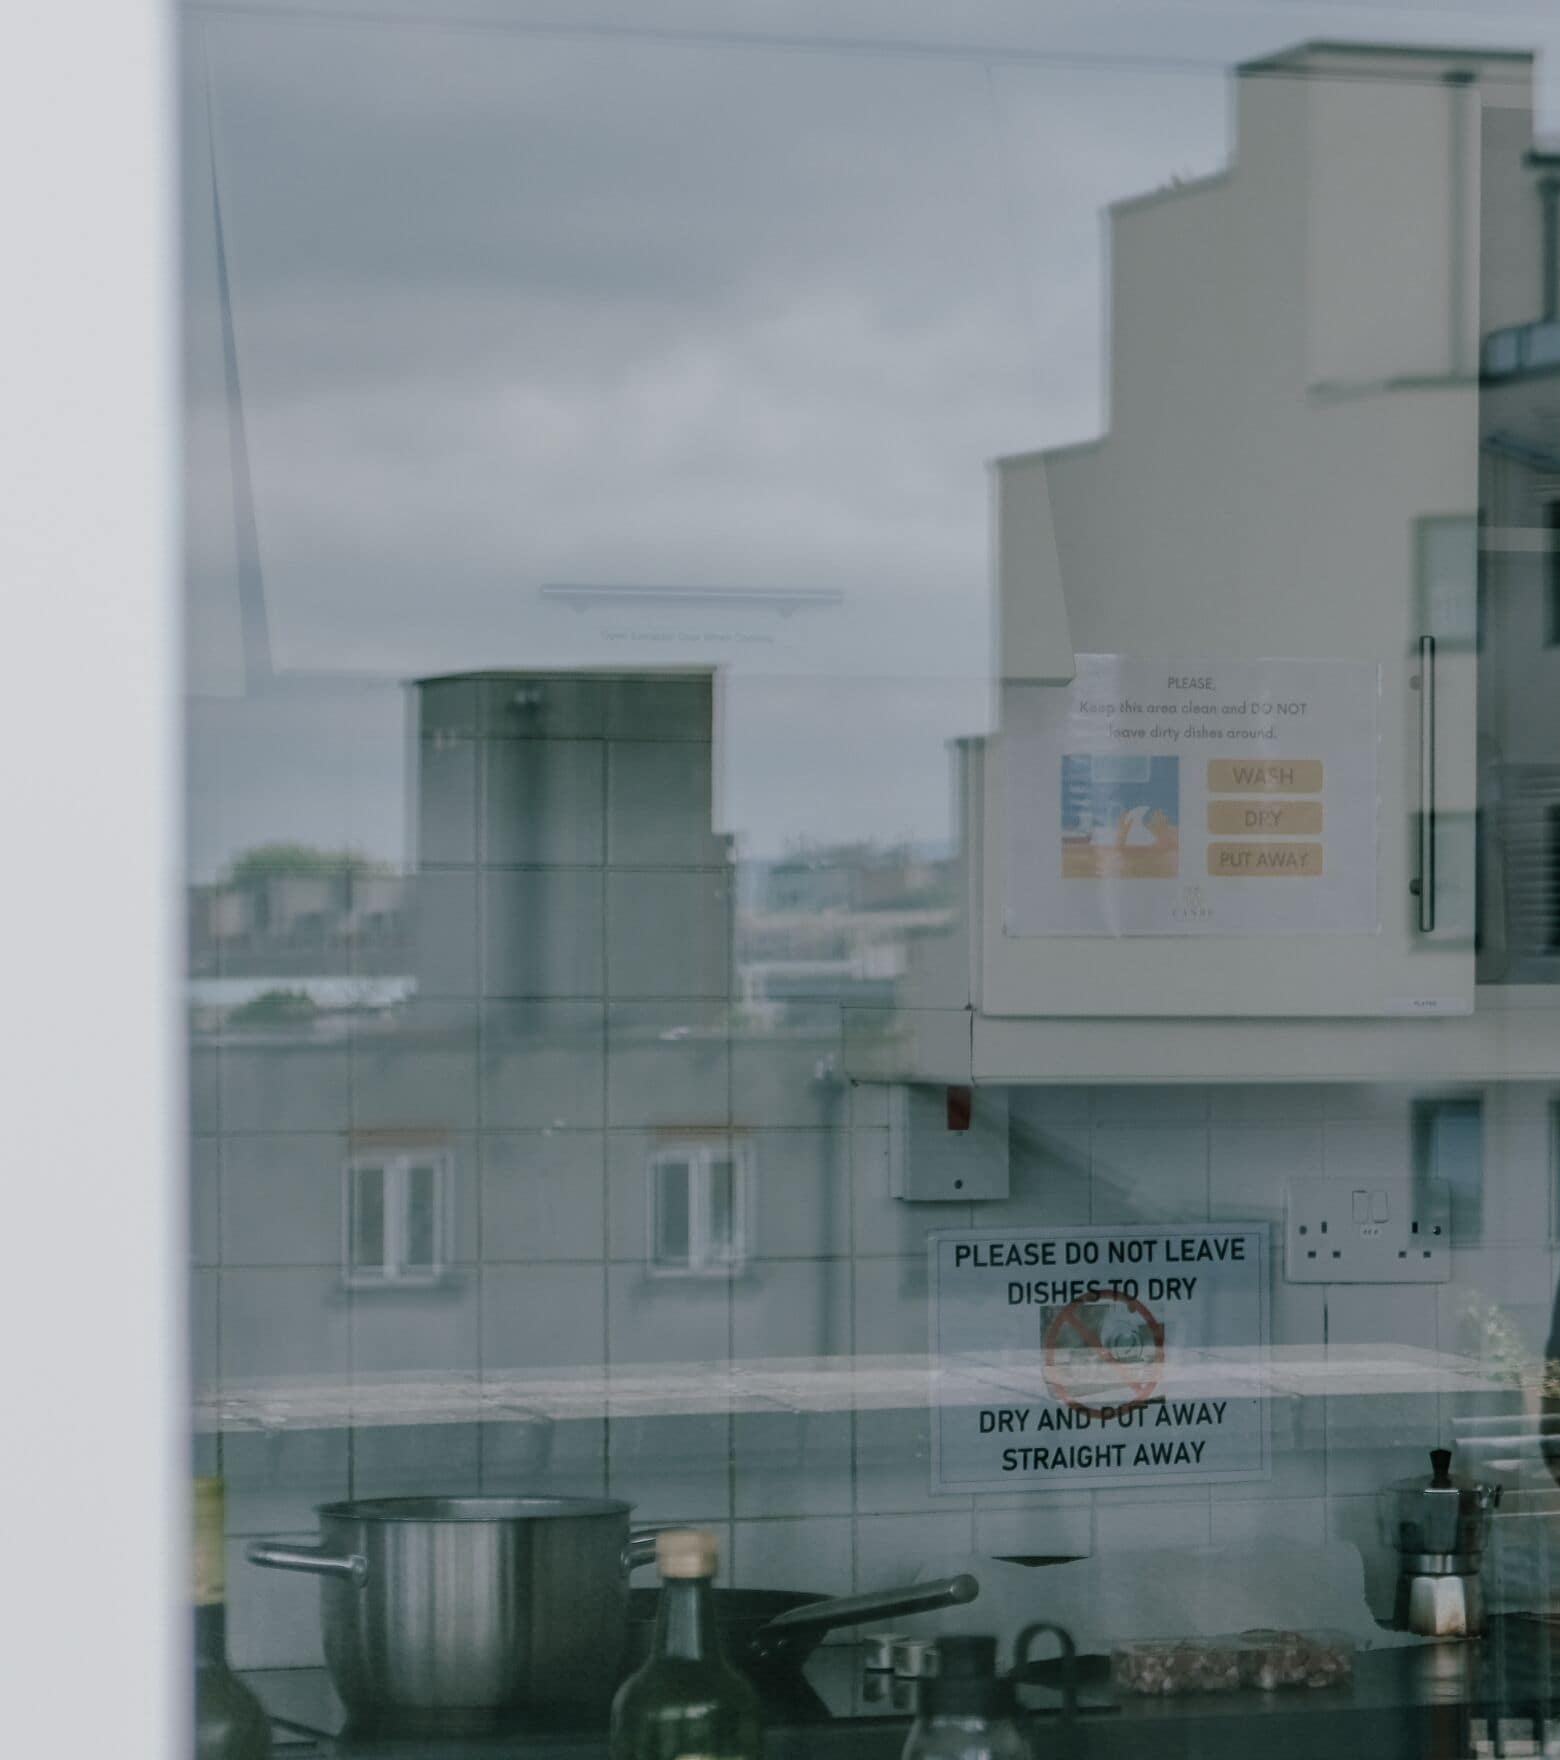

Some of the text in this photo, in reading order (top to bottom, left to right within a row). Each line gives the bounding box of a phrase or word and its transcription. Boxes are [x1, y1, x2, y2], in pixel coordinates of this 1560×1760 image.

[1119, 699, 1143, 714] this
[1146, 703, 1177, 714] area
[1180, 700, 1217, 714] clean
[1221, 700, 1247, 715] and
[1250, 702, 1273, 715] DO
[1276, 702, 1307, 716] NOT
[1150, 723, 1179, 741] dirty
[1183, 724, 1223, 740] dishes
[1232, 766, 1295, 785] WASH
[1244, 809, 1283, 827] DRY
[1219, 851, 1309, 869] PUT AWAY
[954, 1237, 1246, 1268] PLEASE DO NOT LEAVE
[1007, 1277, 1197, 1305] DISHES TO DRY
[979, 1401, 1228, 1434] DRY AND PUT AWAY
[1001, 1440, 1206, 1472] STRAIGHT AWAY
